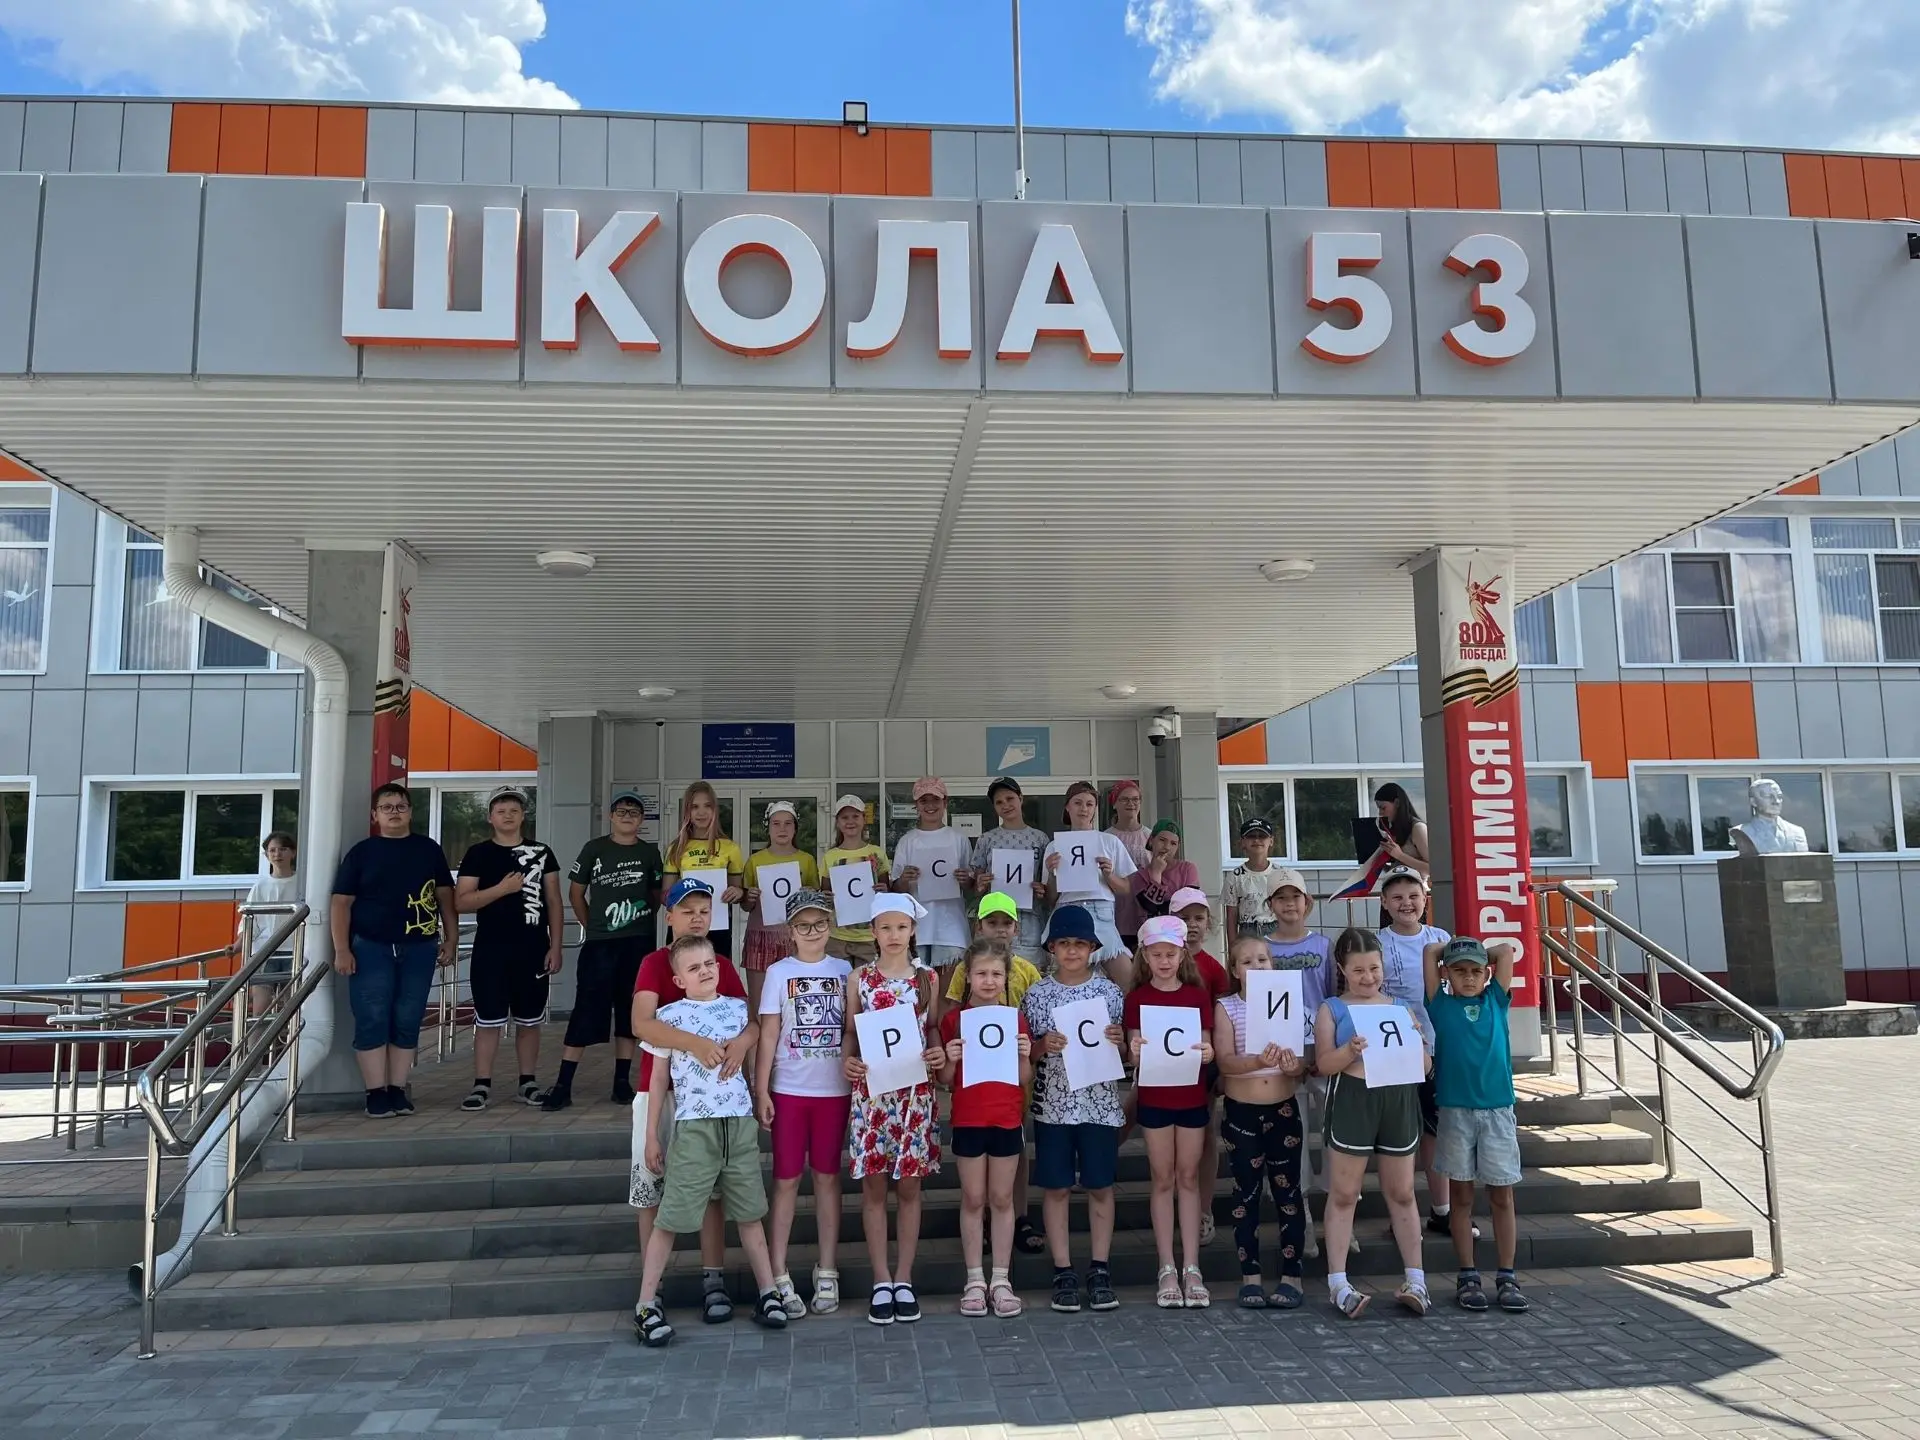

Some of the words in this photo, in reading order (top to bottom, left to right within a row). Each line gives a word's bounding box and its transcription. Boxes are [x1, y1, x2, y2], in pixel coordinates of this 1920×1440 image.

[342, 202, 1124, 363] ШКОЛА
[1300, 231, 1536, 367] 53
[1459, 621, 1484, 644] 80
[1460, 648, 1506, 662] ПОБЕДА!
[1071, 846, 1084, 866] Я
[932, 860, 946, 877] С
[1007, 864, 1021, 883] И
[773, 878, 790, 898] О
[848, 878, 863, 898] С
[1268, 991, 1288, 1019] И
[883, 1028, 901, 1057] Р
[979, 1024, 1004, 1048] О
[1078, 1020, 1099, 1047] С
[1164, 1028, 1184, 1056] С
[1379, 1021, 1402, 1047] Я
[687, 1061, 711, 1082] PANIC
